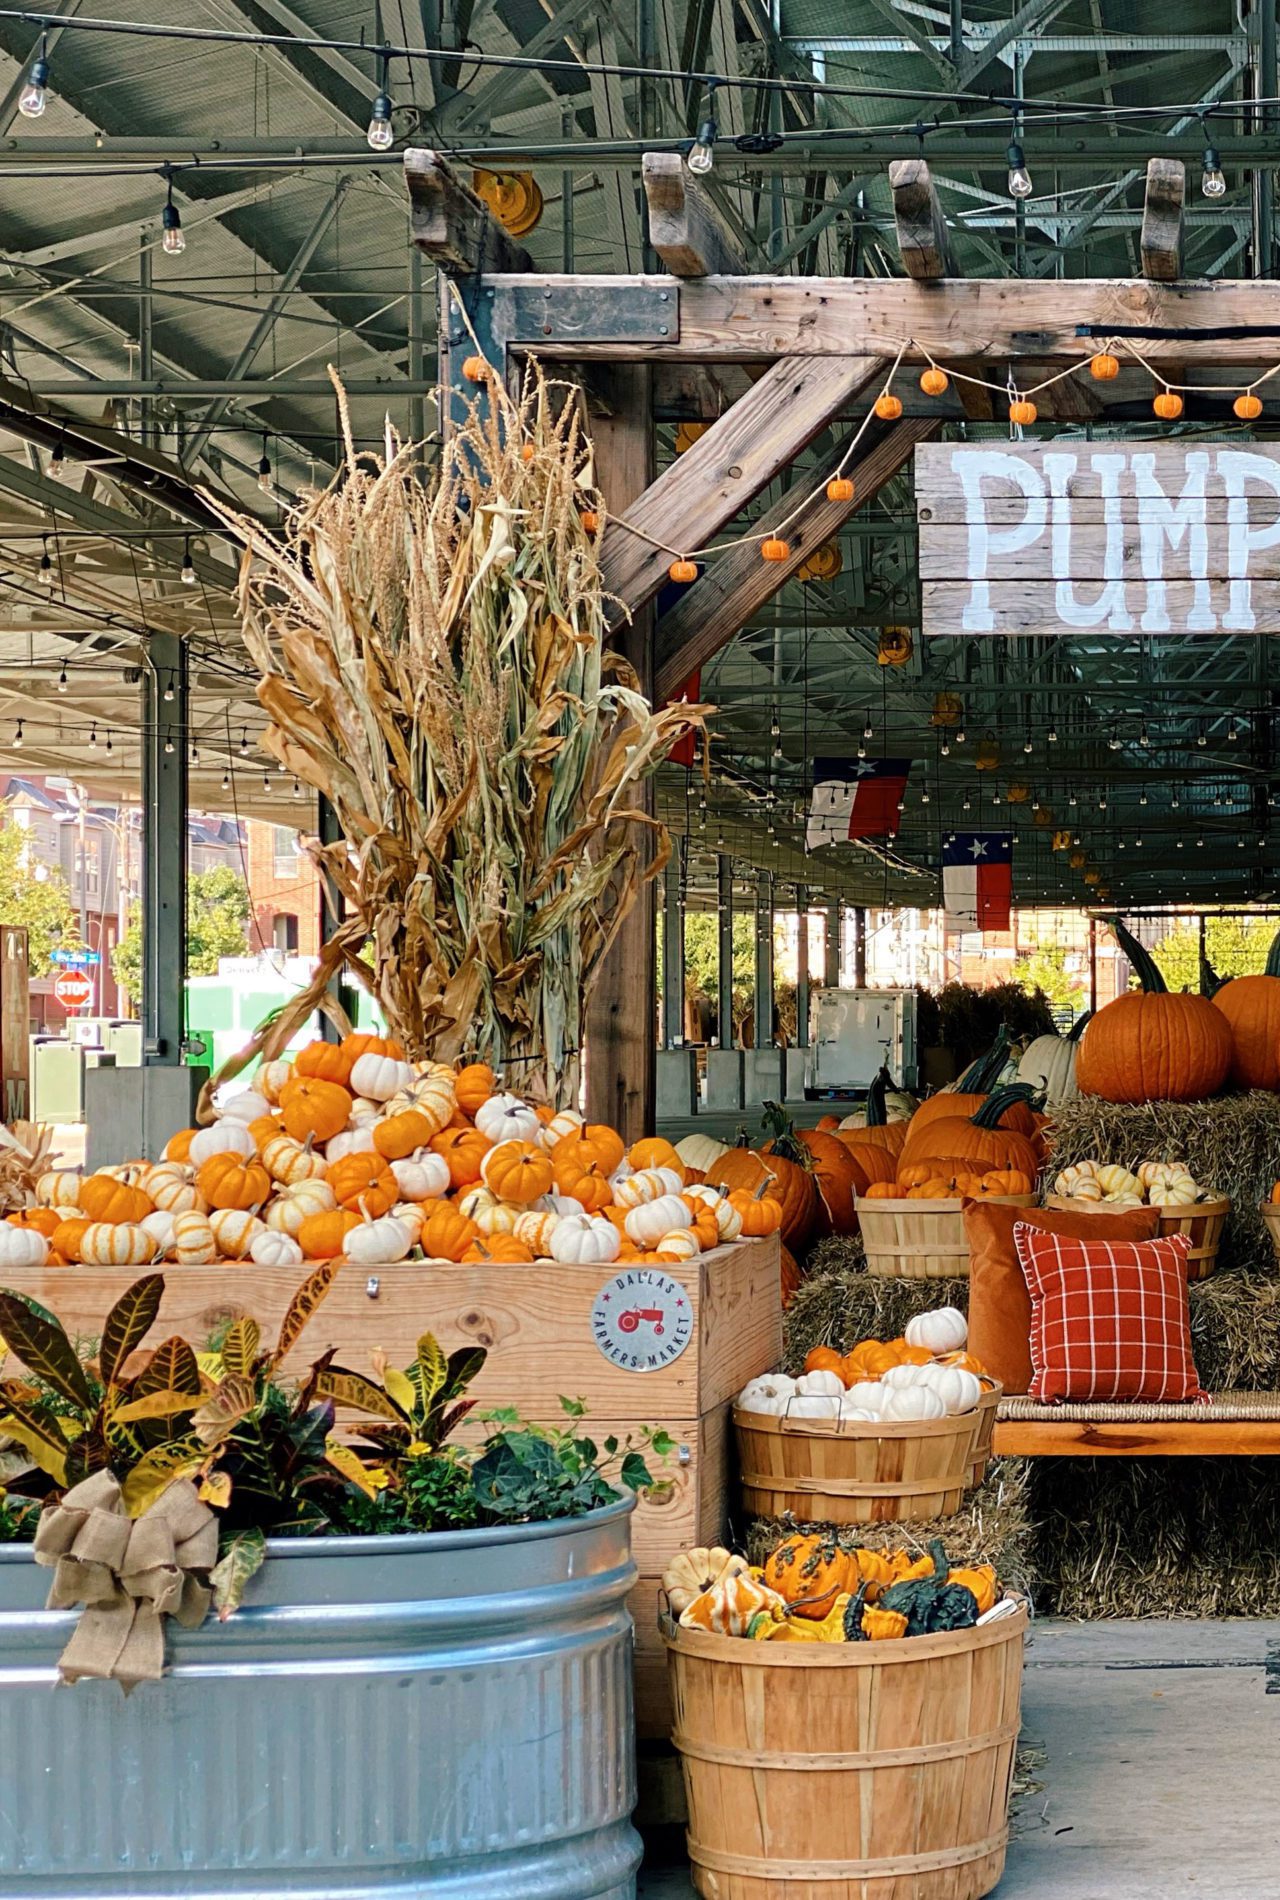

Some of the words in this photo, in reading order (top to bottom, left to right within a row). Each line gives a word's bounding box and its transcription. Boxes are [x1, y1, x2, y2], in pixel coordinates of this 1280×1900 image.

[57, 981, 90, 996] STOP
[616, 1272, 675, 1294] DALLAS
[594, 1311, 638, 1367] FARMERS
[648, 1318, 690, 1367] MARKET
